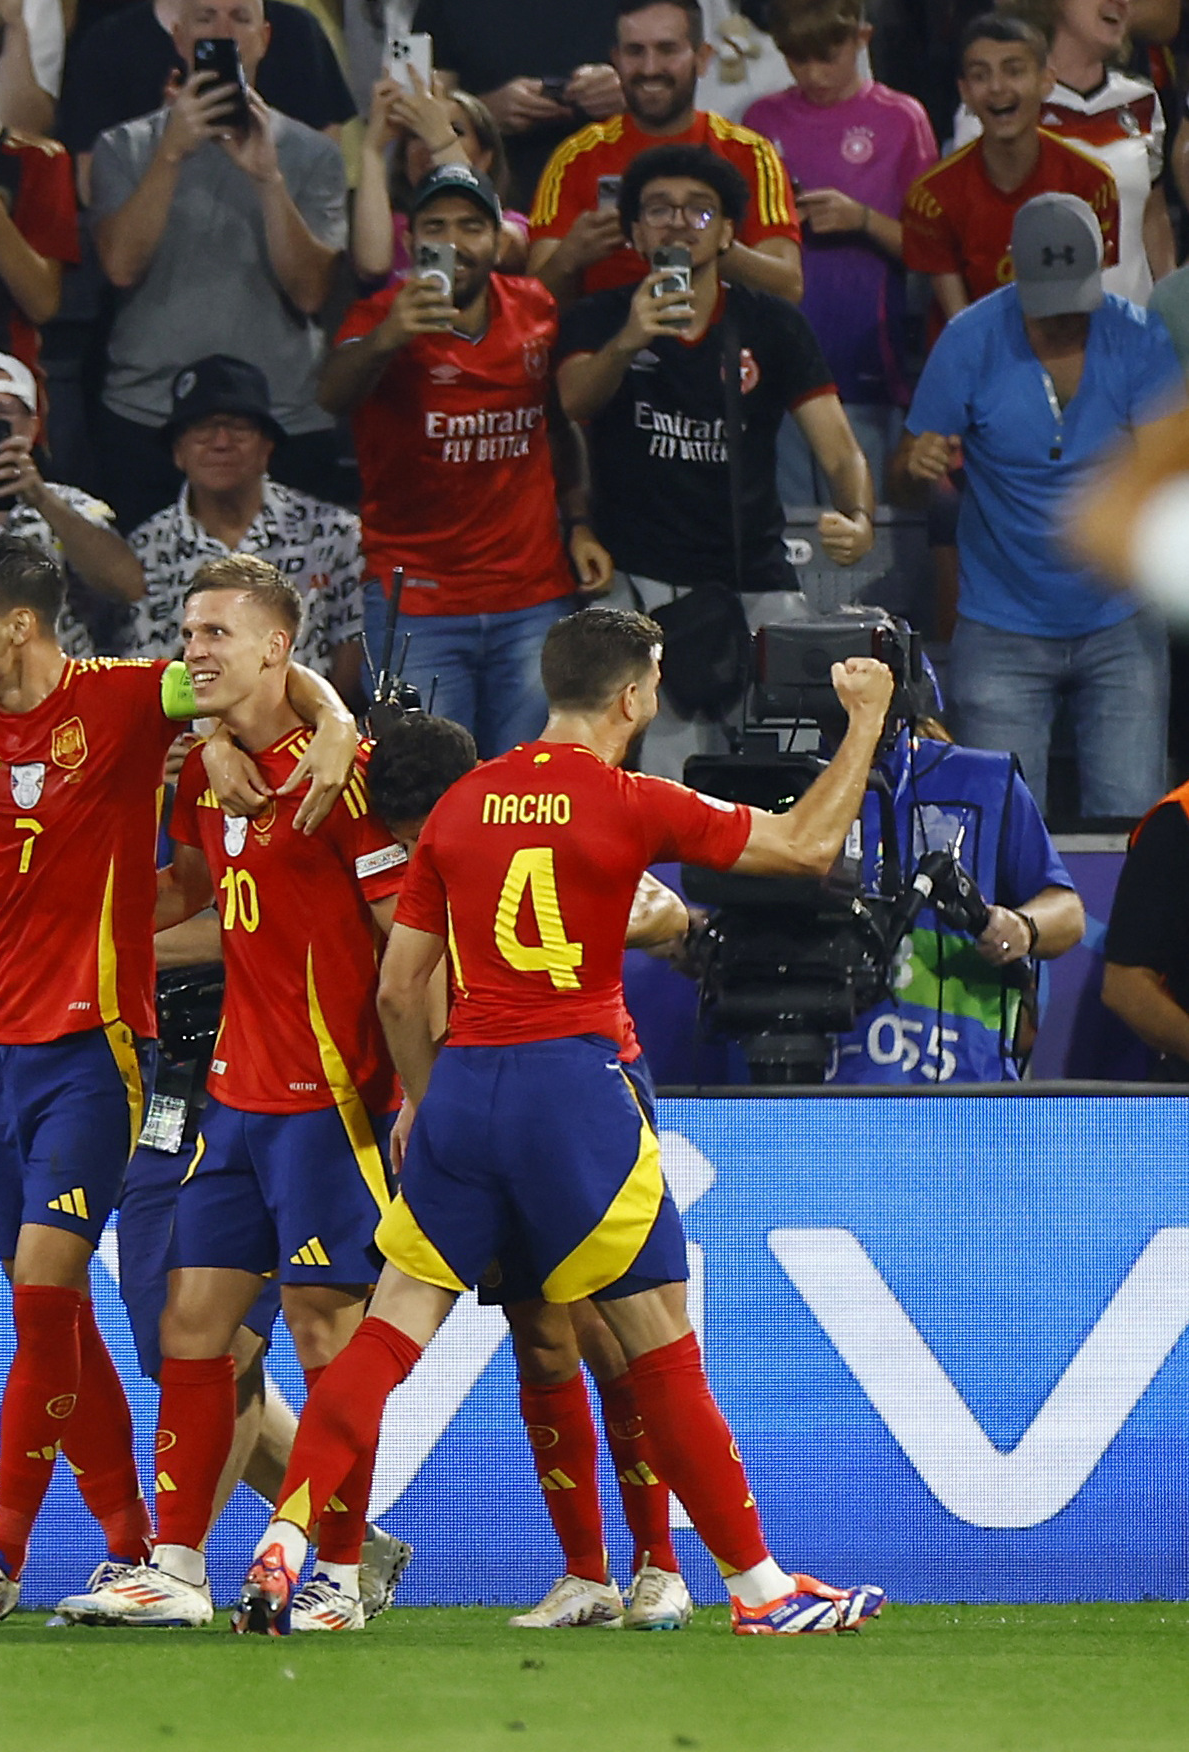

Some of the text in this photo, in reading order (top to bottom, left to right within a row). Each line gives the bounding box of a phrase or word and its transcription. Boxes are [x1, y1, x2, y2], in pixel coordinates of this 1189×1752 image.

[635, 400, 729, 439] Emirat
[442, 439, 473, 463] FLY
[482, 793, 571, 825] NACHO
[15, 818, 44, 873] 7
[220, 866, 260, 933] 10
[494, 847, 583, 991] 4
